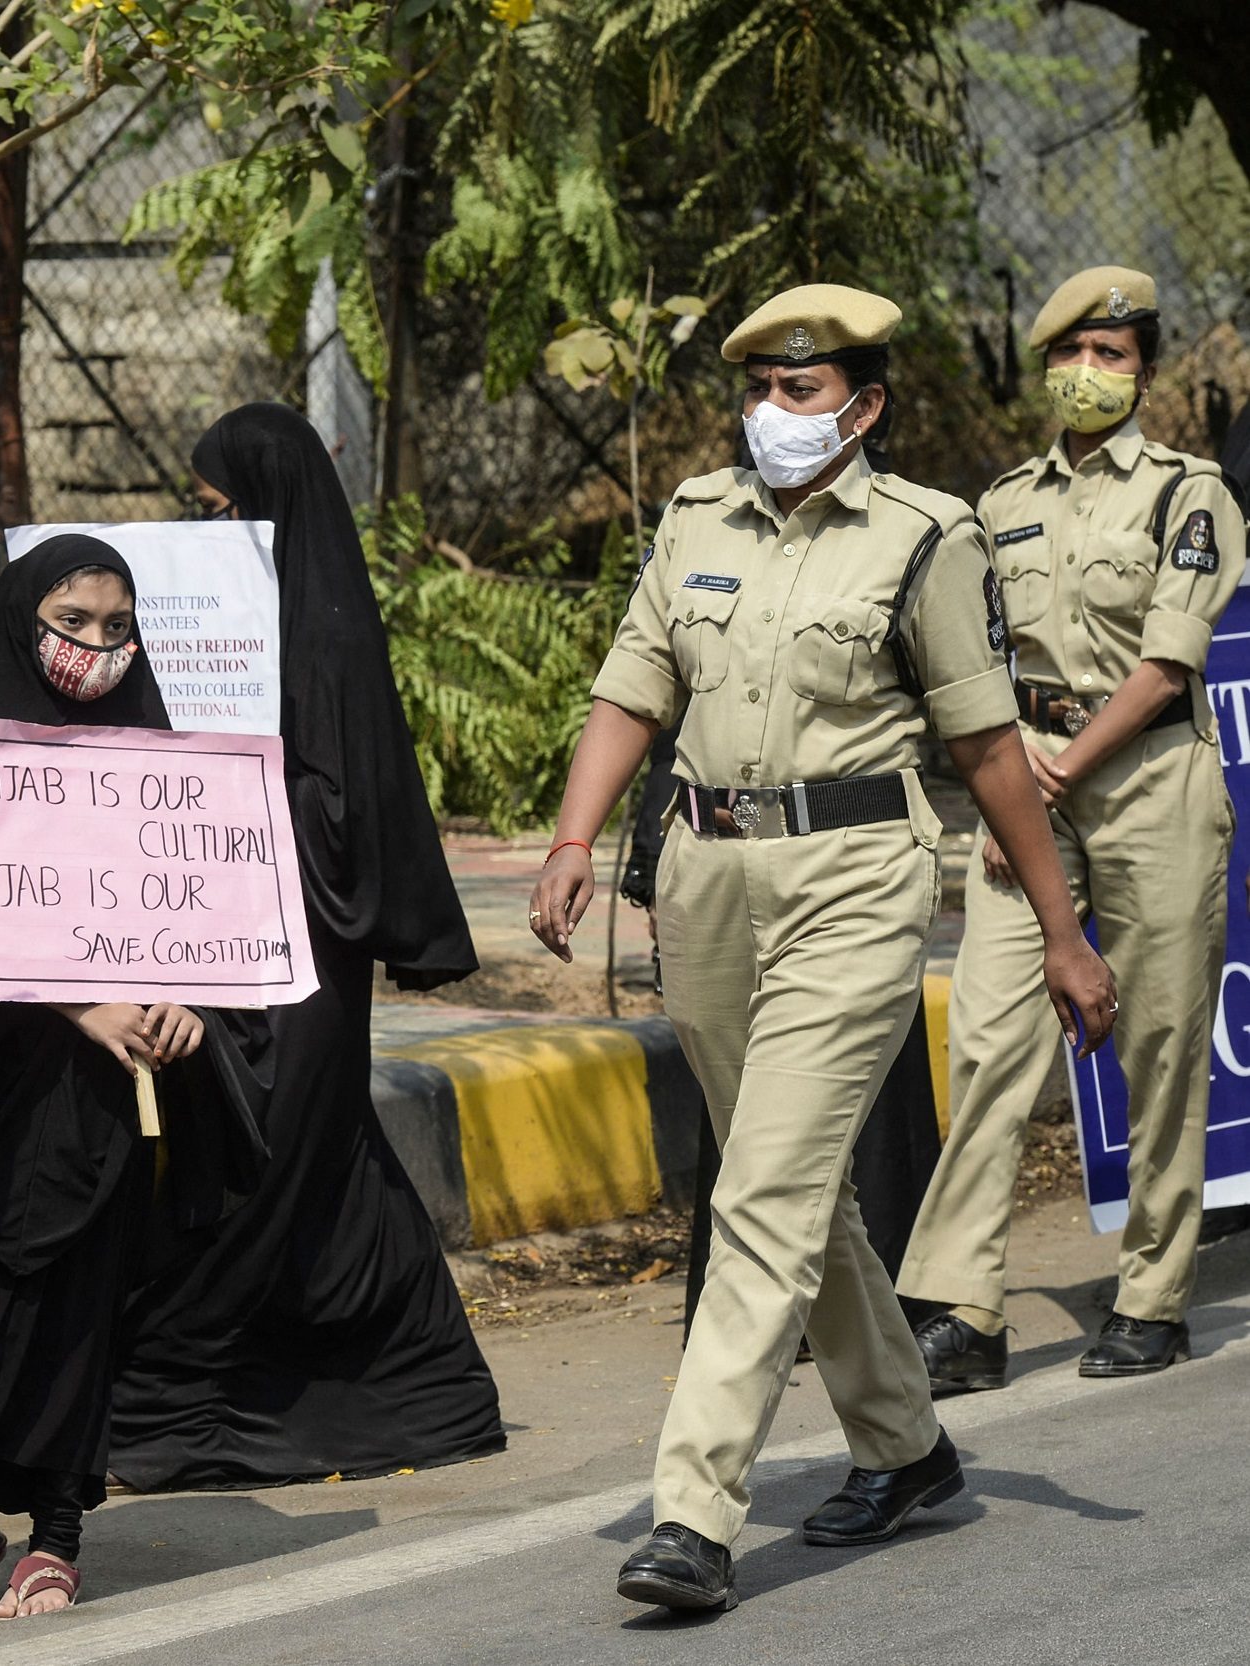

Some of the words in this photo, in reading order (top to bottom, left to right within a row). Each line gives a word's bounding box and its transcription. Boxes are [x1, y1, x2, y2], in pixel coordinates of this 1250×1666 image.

[1178, 553, 1214, 569] POLICE
[141, 616, 200, 630] RANTEES
[196, 639, 264, 653] FREEDOM
[167, 659, 248, 673] EDUCATION
[169, 683, 201, 696] INTO
[205, 683, 264, 697] COLLEGE
[90, 771, 121, 807] IS
[140, 774, 206, 810] OUR
[138, 821, 276, 865] CULTURAL
[89, 868, 117, 909] IS
[141, 873, 213, 911] OUR
[64, 925, 145, 966] SAVE
[152, 927, 292, 966] CONSTITUTION
